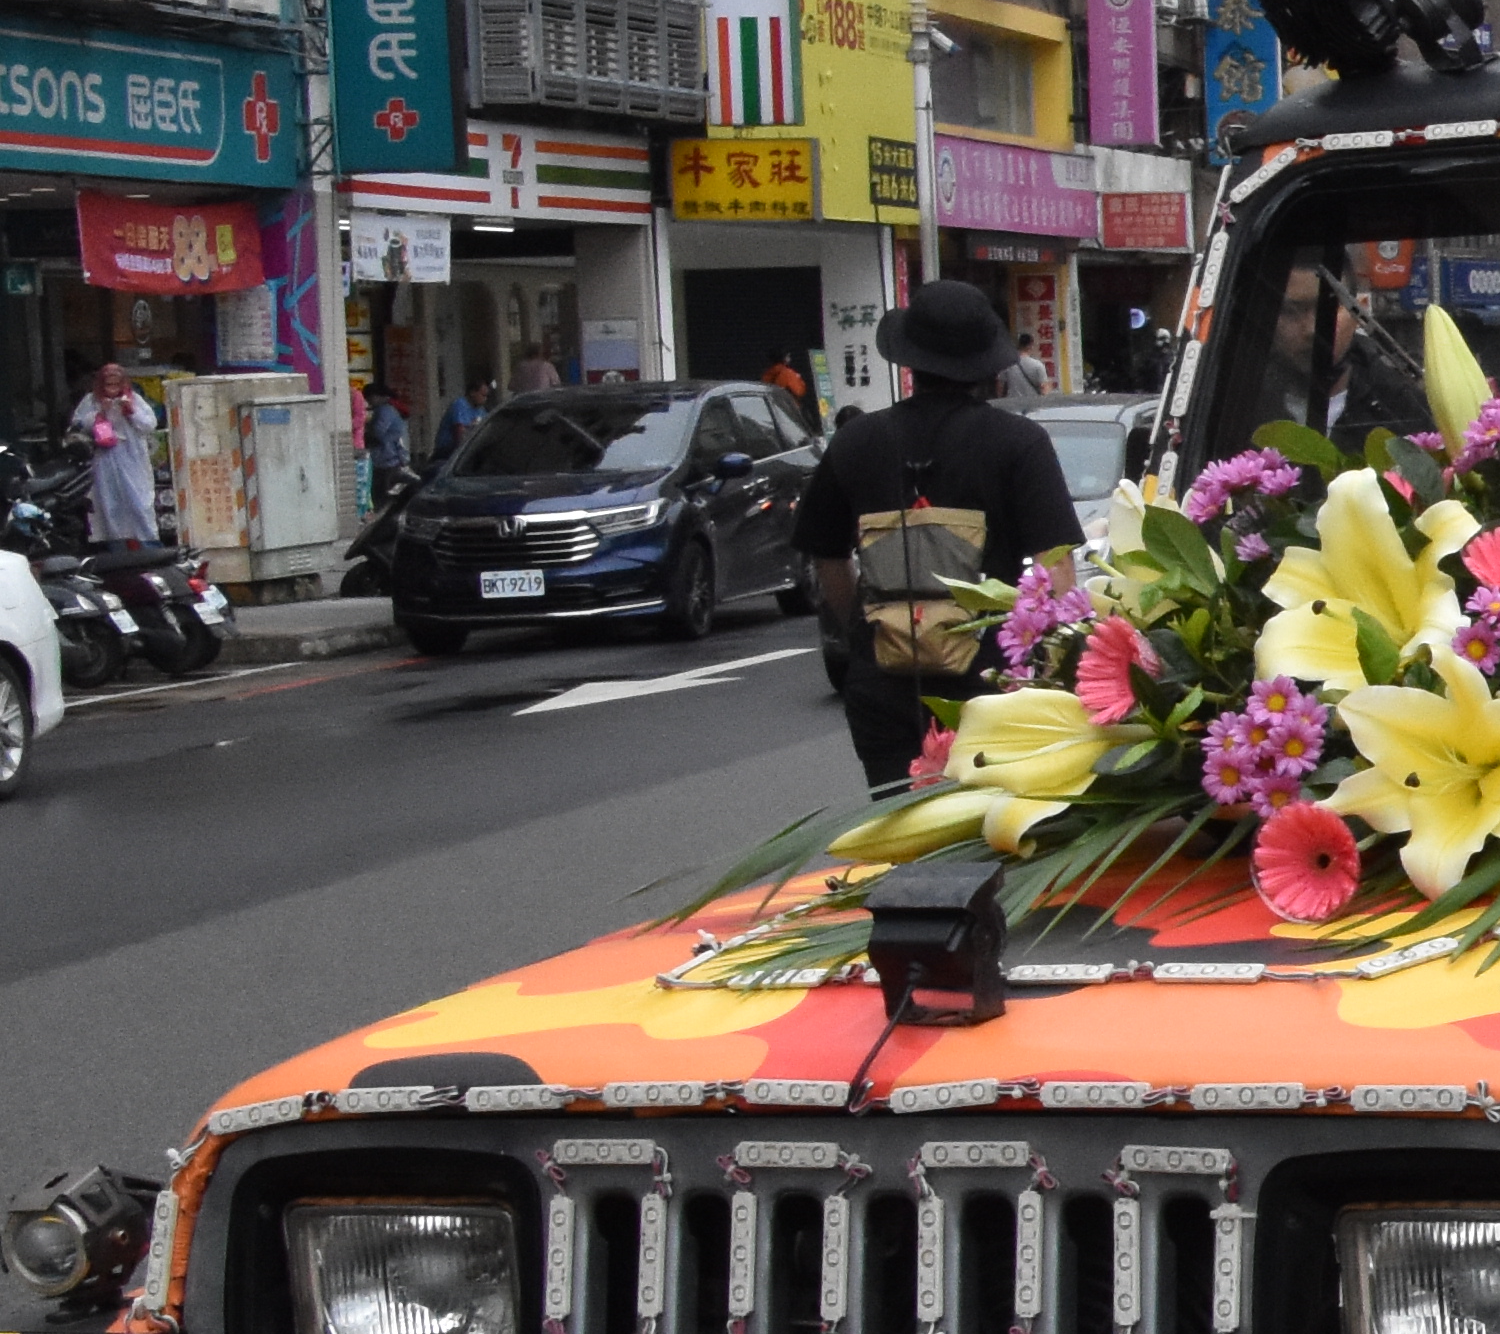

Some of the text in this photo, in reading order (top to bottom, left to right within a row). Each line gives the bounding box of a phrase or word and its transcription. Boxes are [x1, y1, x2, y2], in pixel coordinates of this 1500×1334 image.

[127, 73, 201, 134] 屈臣氏
[482, 576, 543, 594] BKT-9219
